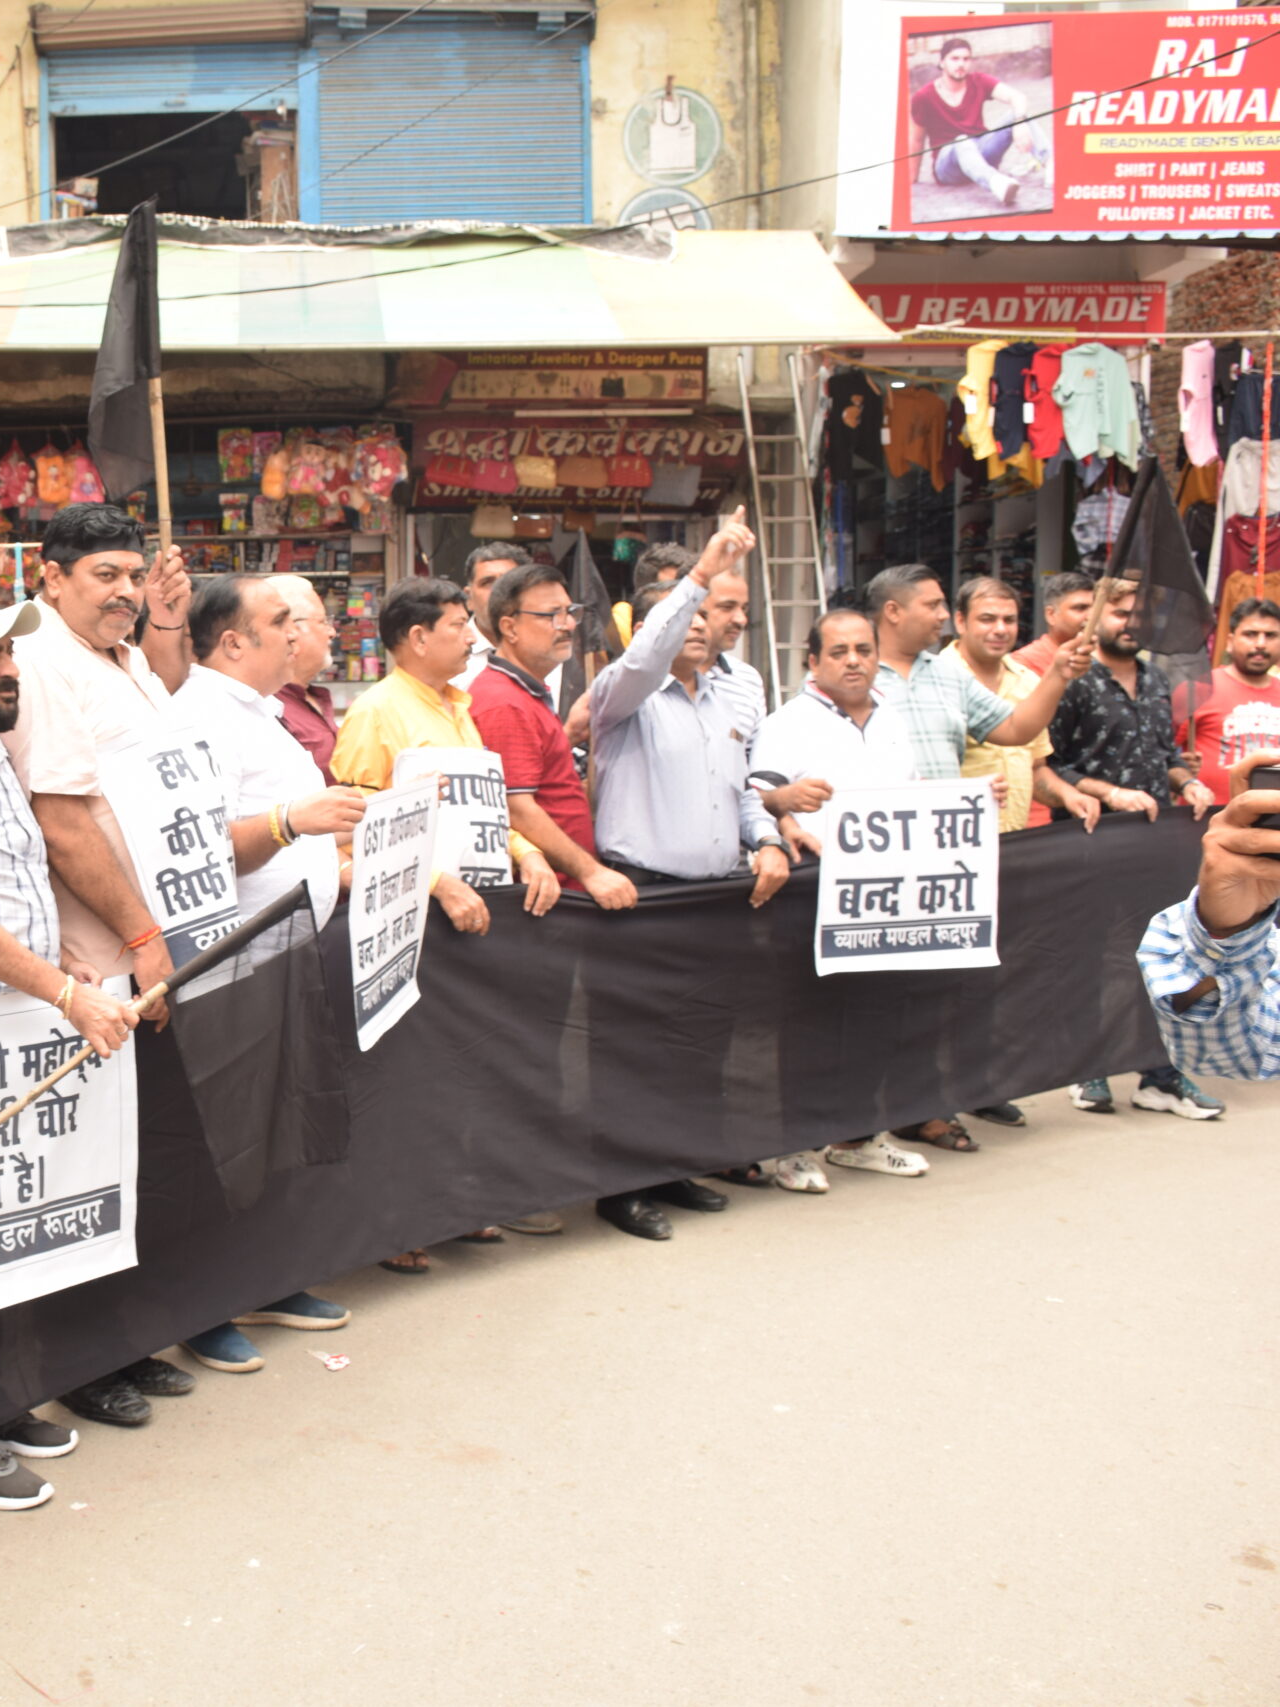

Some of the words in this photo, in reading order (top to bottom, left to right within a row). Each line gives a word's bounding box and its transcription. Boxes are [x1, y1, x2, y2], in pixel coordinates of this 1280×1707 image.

[1150, 37, 1250, 79] RAJ
[1100, 136, 1187, 149] READYMADE
[1191, 136, 1239, 148] GENTS
[1115, 163, 1156, 177] SHIRT
[1170, 162, 1207, 177] PANT
[1221, 161, 1265, 176] JEANS
[1064, 185, 1126, 199] JOGGERS
[1141, 184, 1211, 199] TROUSERS
[1098, 206, 1175, 221] PULLOVERS
[1189, 205, 1241, 220] JACKET
[1244, 205, 1274, 219] ETC.
[920, 296, 1152, 323] READYMADE
[468, 351, 527, 364] Imitation
[530, 352, 590, 367] Jewellery
[595, 352, 604, 364] &
[608, 351, 665, 367] Designer
[669, 352, 704, 365] Purse
[160, 807, 208, 856] की
[364, 817, 386, 857] GST
[838, 811, 917, 853] GST
[932, 795, 984, 849] सर्वे
[155, 851, 227, 918] सिर्फ
[836, 876, 904, 918] बन्द
[917, 860, 978, 914] करो
[834, 928, 882, 949] व्यापार
[885, 925, 932, 947] मण्डल
[35, 1087, 80, 1139] चोर
